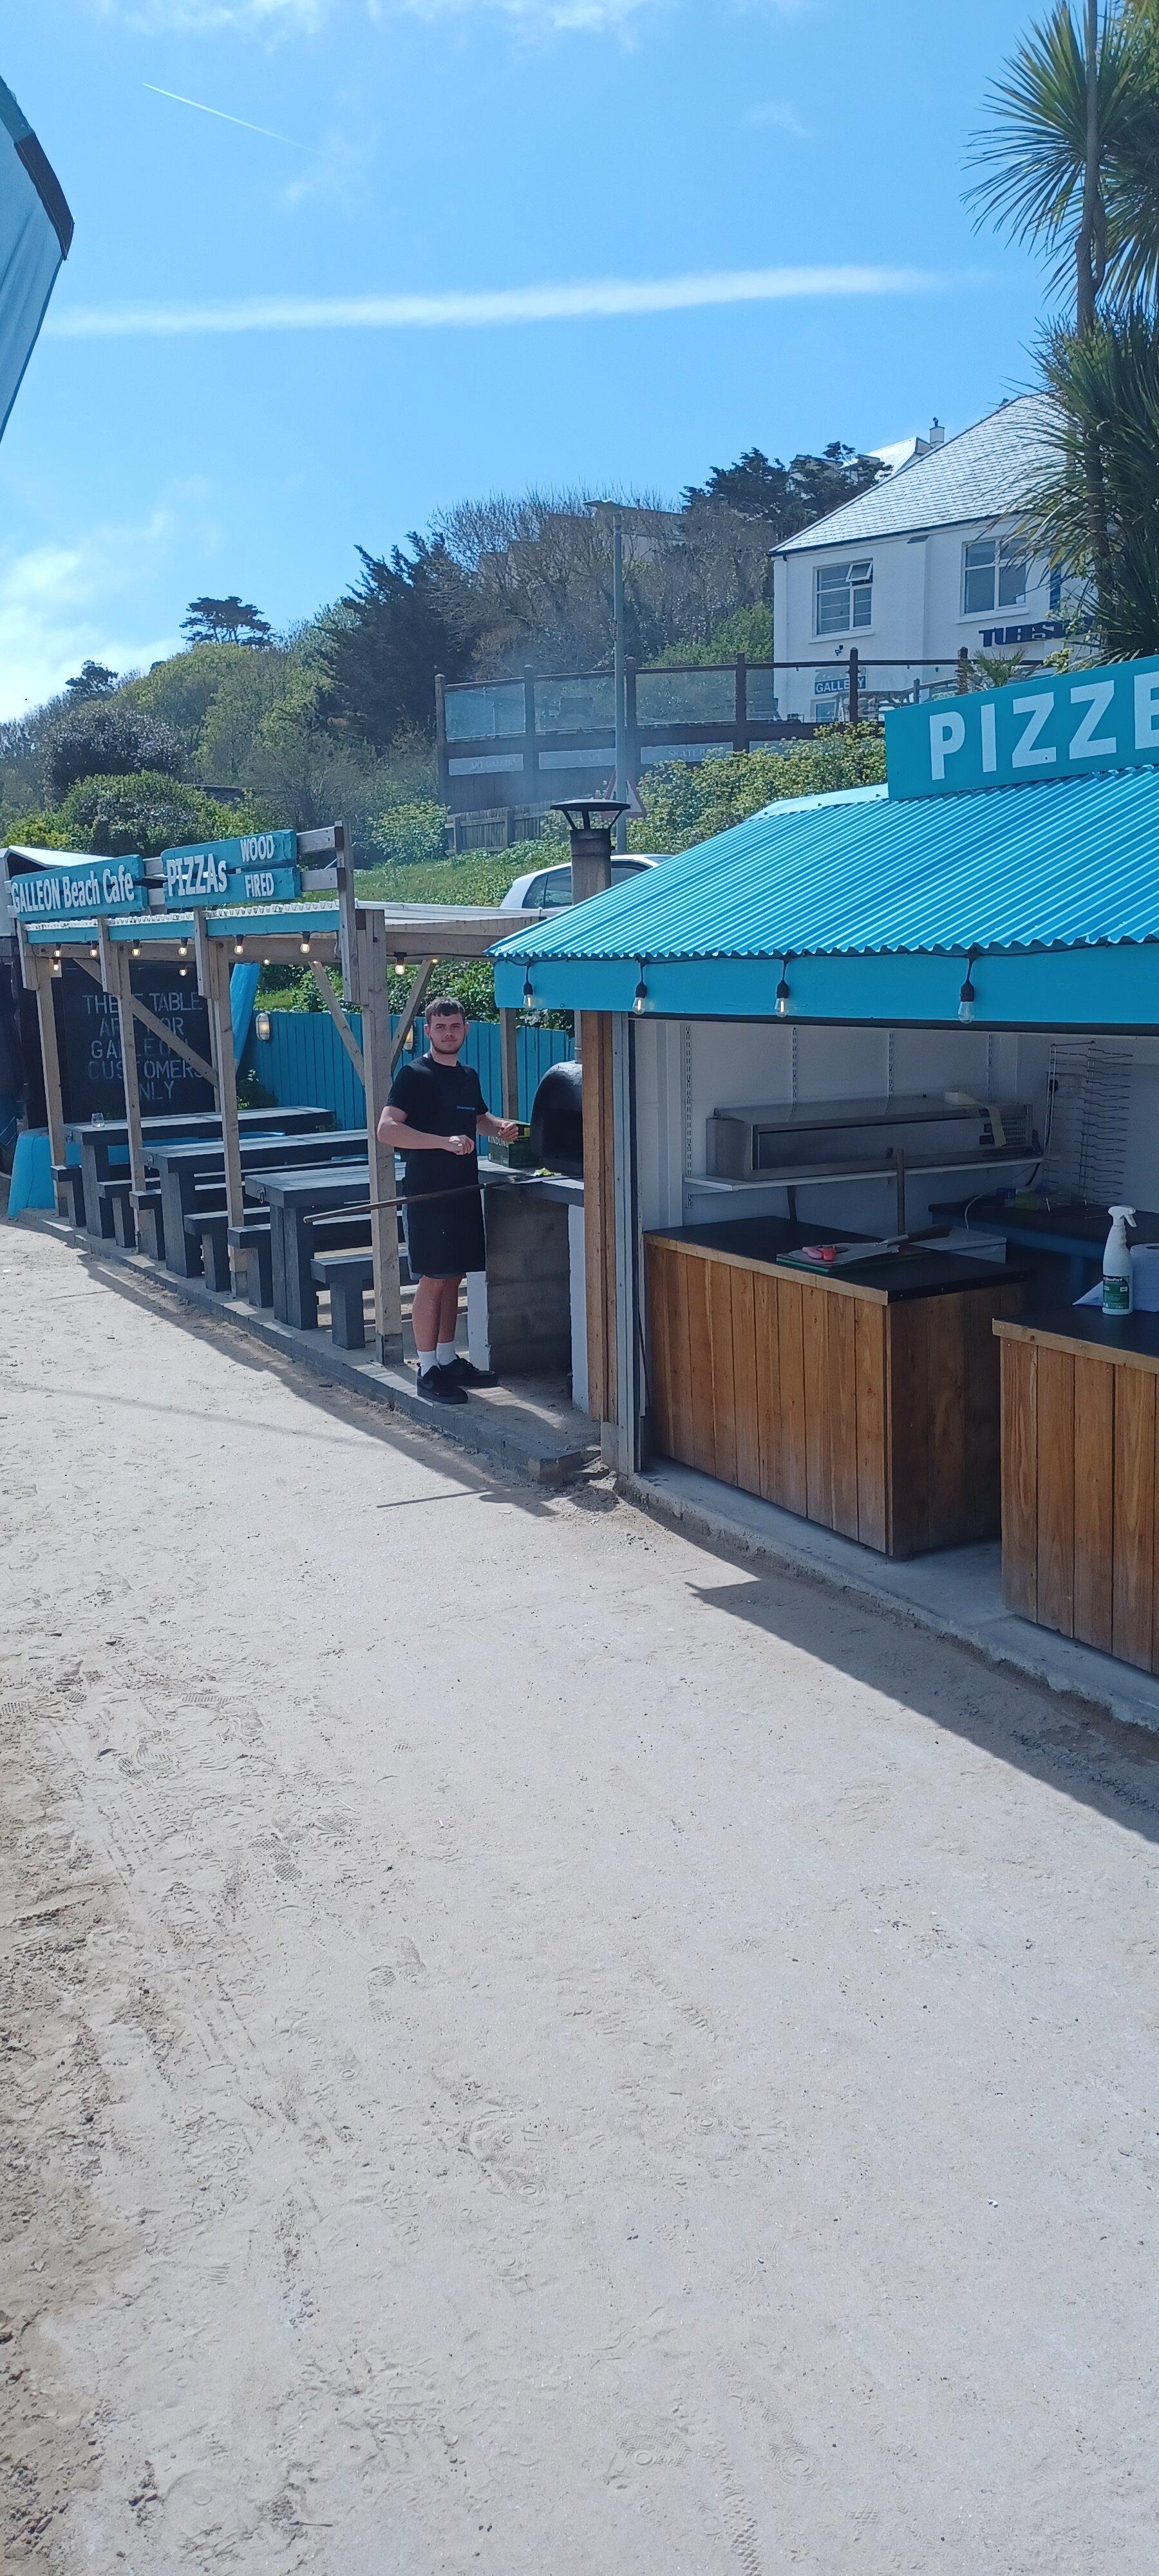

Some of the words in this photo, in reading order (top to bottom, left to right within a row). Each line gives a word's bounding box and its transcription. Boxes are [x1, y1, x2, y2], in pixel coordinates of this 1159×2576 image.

[816, 678, 864, 693] GALLEY
[240, 835, 274, 862] WOOD
[11, 878, 61, 913] GALLEON
[62, 871, 100, 908] Beach
[103, 864, 135, 904] Cafe
[245, 873, 274, 898] FIRED
[138, 1081, 174, 1101] NLY
